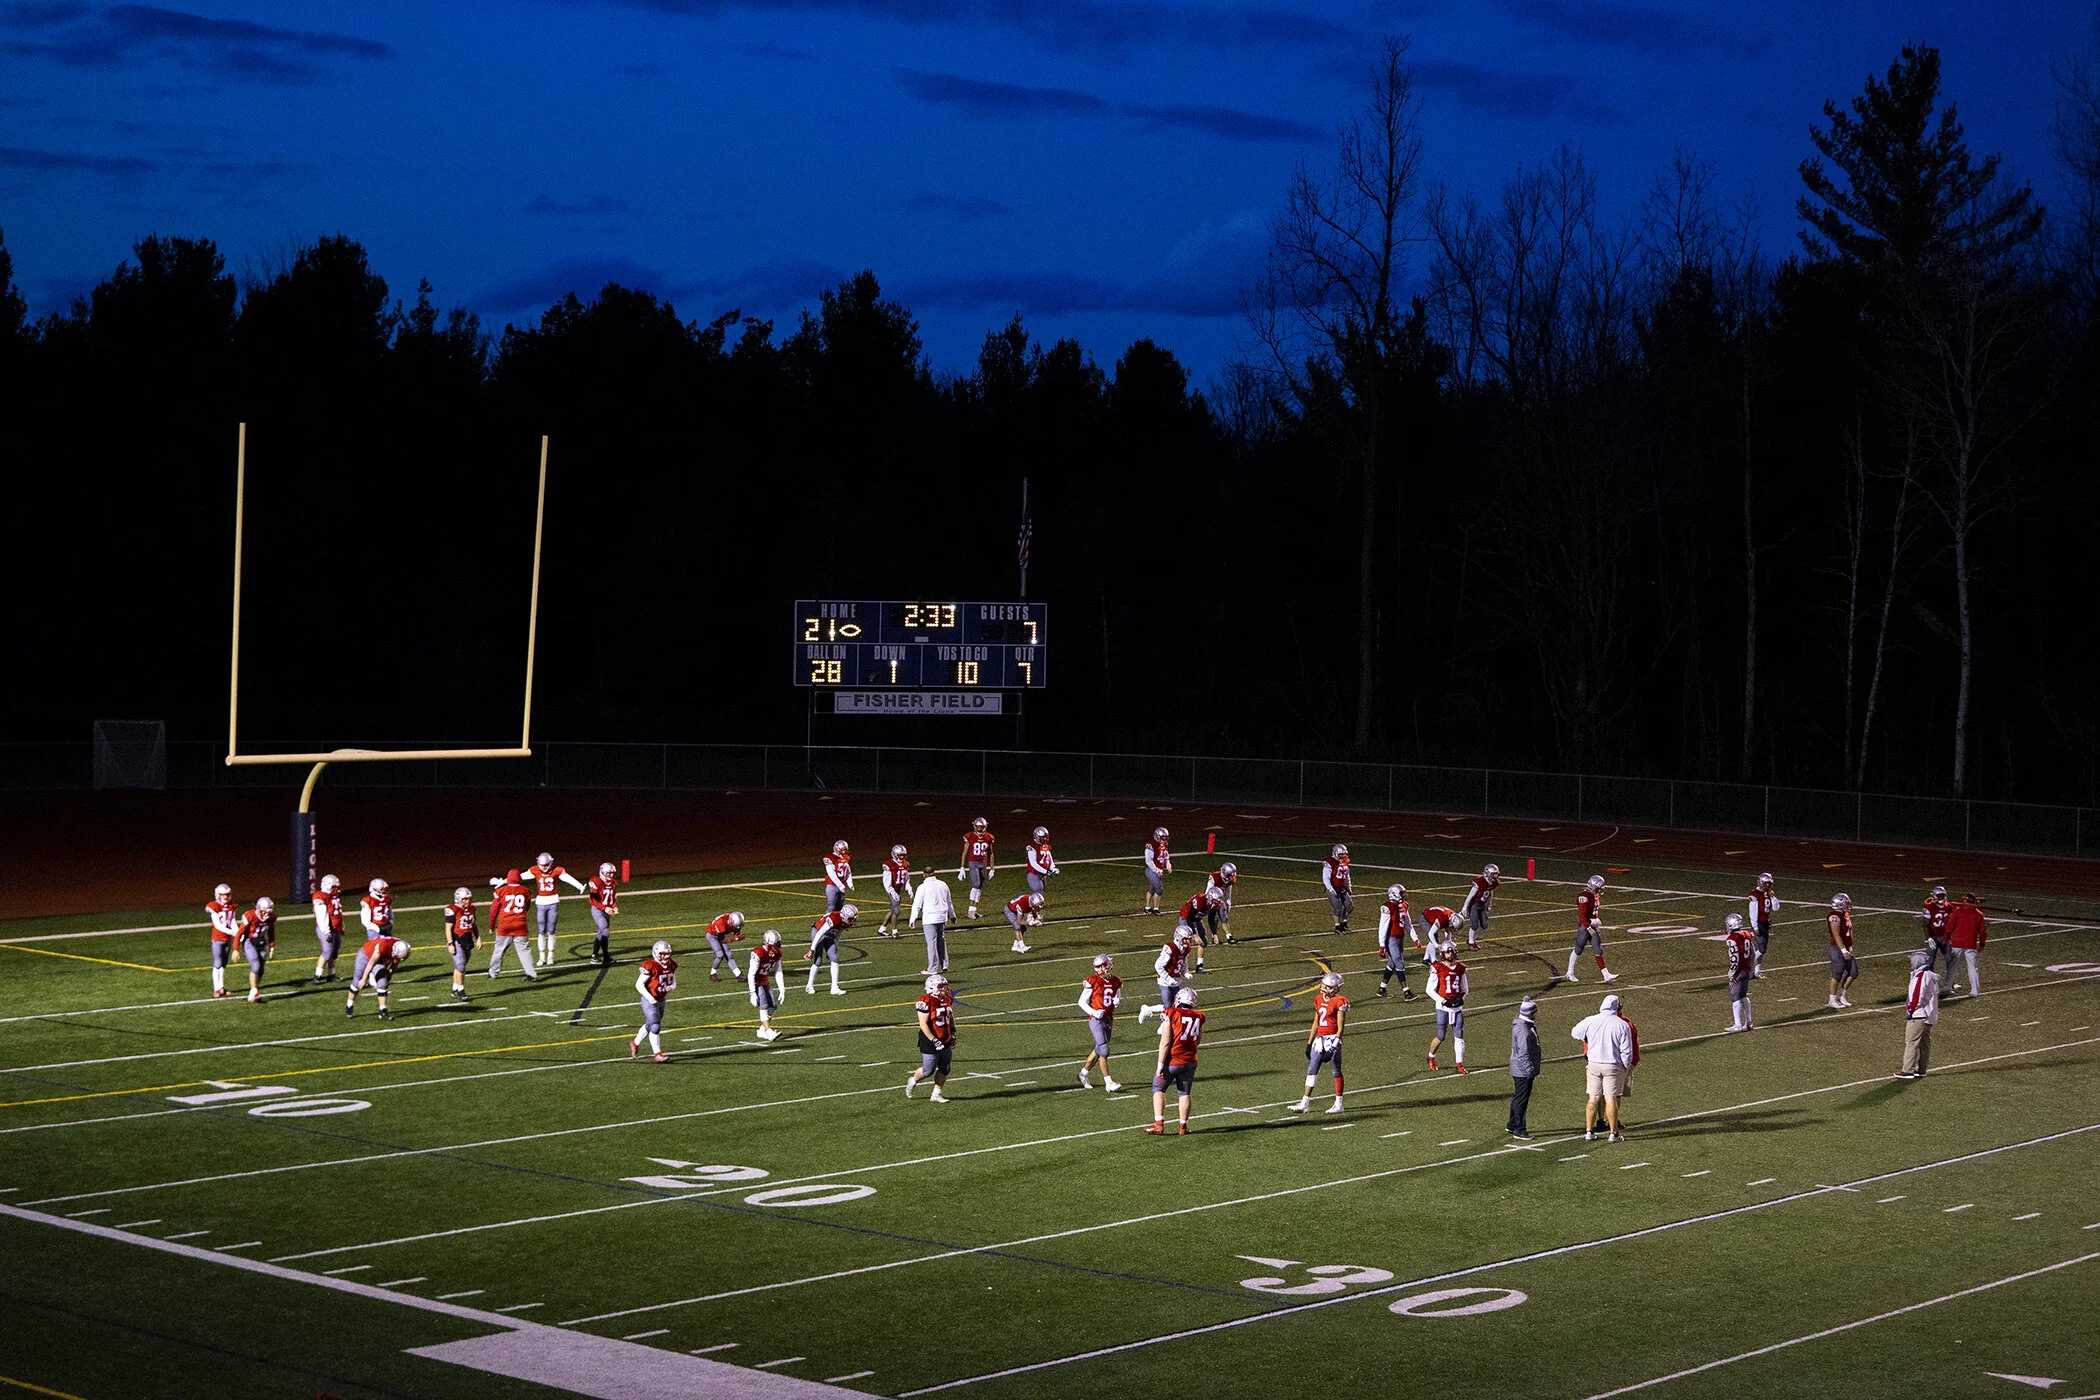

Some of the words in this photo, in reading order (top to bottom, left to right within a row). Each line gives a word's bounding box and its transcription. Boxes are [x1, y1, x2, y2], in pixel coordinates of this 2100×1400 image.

[821, 604, 857, 618] HOME
[905, 604, 956, 627] 2:33
[980, 605, 1030, 620] GUESTS
[805, 619, 835, 641] 21
[1023, 621, 1038, 645] 7
[806, 645, 831, 659] BALL
[832, 645, 847, 660] ON
[874, 646, 906, 660] DOWN
[937, 646, 957, 660] YDS
[959, 646, 972, 661] TO
[974, 647, 988, 661] GO
[1015, 647, 1035, 662] QTR
[811, 660, 842, 683] 28
[890, 660, 898, 684] 1
[958, 661, 979, 684] 10
[1018, 662, 1031, 685] 7
[853, 694, 924, 708] FISHER
[930, 694, 985, 708] FIELD
[538, 877, 554, 892] 13
[504, 894, 525, 914] 79
[1743, 938, 1751, 959] 9
[1445, 975, 1460, 994] 14
[1103, 988, 1114, 1007] 6
[1318, 1007, 1328, 1027] 2
[1181, 1016, 1201, 1041] 74
